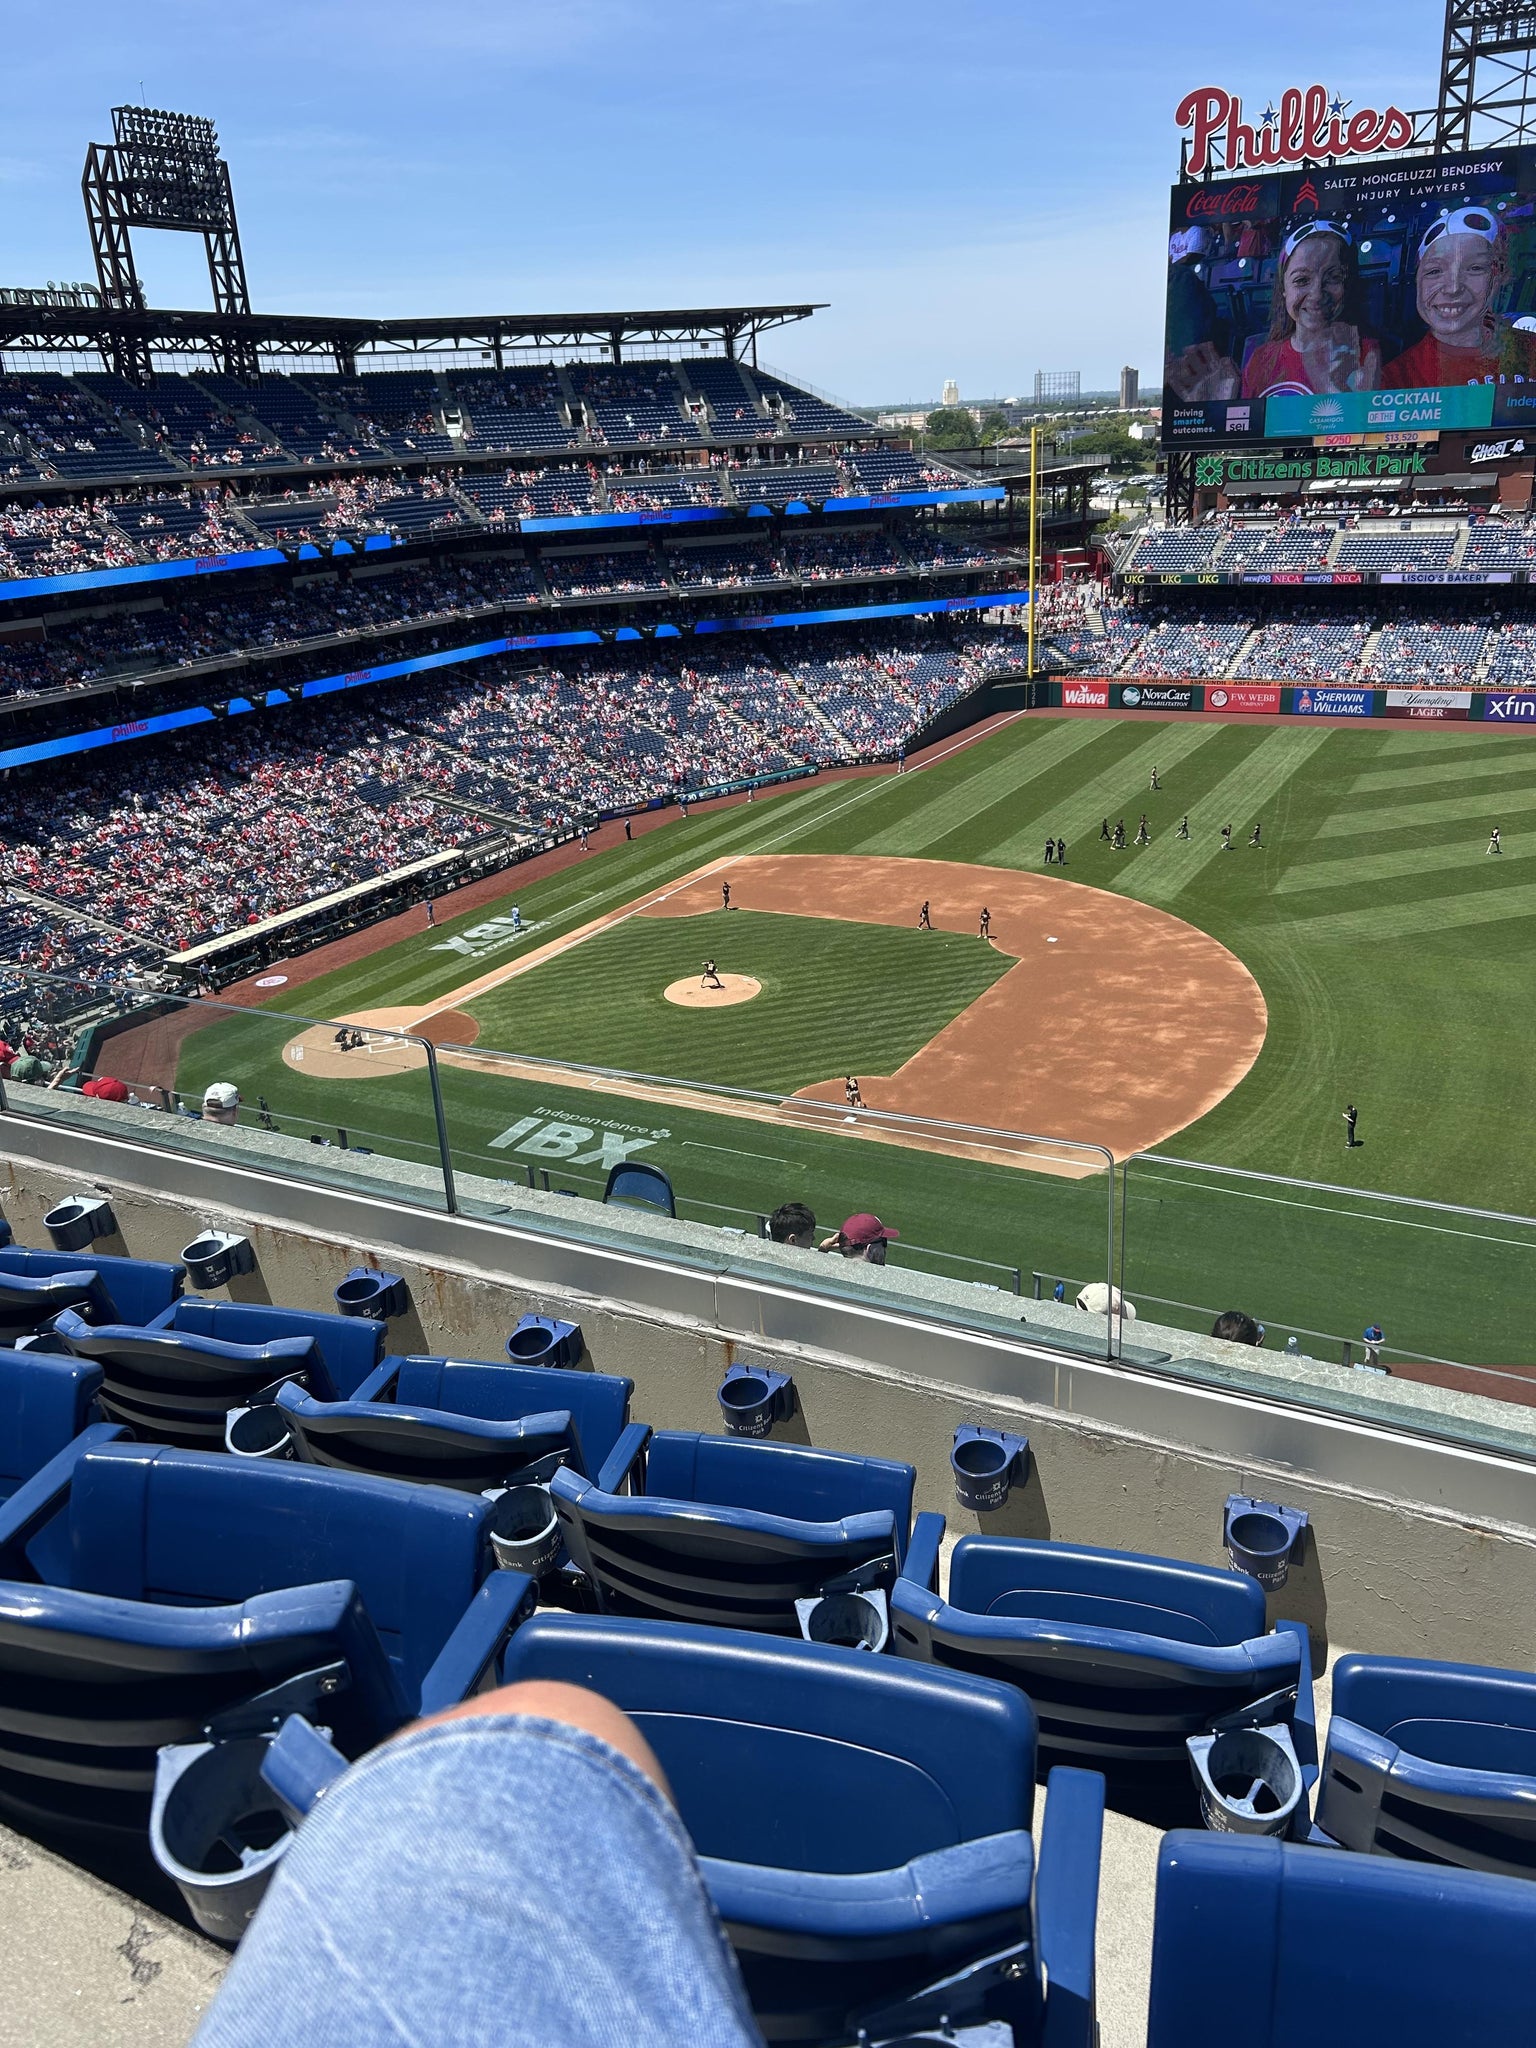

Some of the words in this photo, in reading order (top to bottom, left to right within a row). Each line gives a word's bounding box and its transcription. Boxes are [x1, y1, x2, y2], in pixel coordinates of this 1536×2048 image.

[1175, 84, 1413, 176] Phillies
[1324, 176, 1357, 190] SALTZ
[1362, 168, 1437, 187] MONGELUZZI
[1441, 161, 1503, 177] BENDESKY
[1356, 189, 1401, 202] INJURY
[1410, 181, 1466, 196] LAWYERS
[1186, 184, 1263, 218] Coca-Cola
[1371, 391, 1443, 407] COCKTAIL
[1173, 408, 1204, 418] Driving
[1369, 412, 1379, 422] OF
[1381, 411, 1394, 421] THE
[1399, 408, 1442, 422] GAME
[1173, 417, 1205, 426] smarter
[1172, 426, 1216, 435] outcomes.
[1470, 438, 1515, 465] GHOST
[1227, 460, 1312, 481] Citizens
[1316, 456, 1372, 478] Bank
[1375, 452, 1427, 475] Park
[1124, 575, 1145, 584] UKG
[1160, 575, 1181, 584] UKG
[1197, 574, 1219, 584] UKG
[1273, 575, 1300, 583] NECA
[1334, 574, 1362, 583] NECA
[1401, 574, 1445, 582] LISCIO'S
[1447, 574, 1489, 582] BAKERY
[1065, 690, 1106, 705] Wawa
[1141, 688, 1191, 701] NovaCare
[1248, 693, 1276, 702] WEBB
[1315, 690, 1364, 703] SHERWIN
[1401, 692, 1456, 707] Yuengling
[1409, 708, 1444, 717] LAGER
[532, 1106, 649, 1134] Independence
[487, 1116, 658, 1171] IBX
